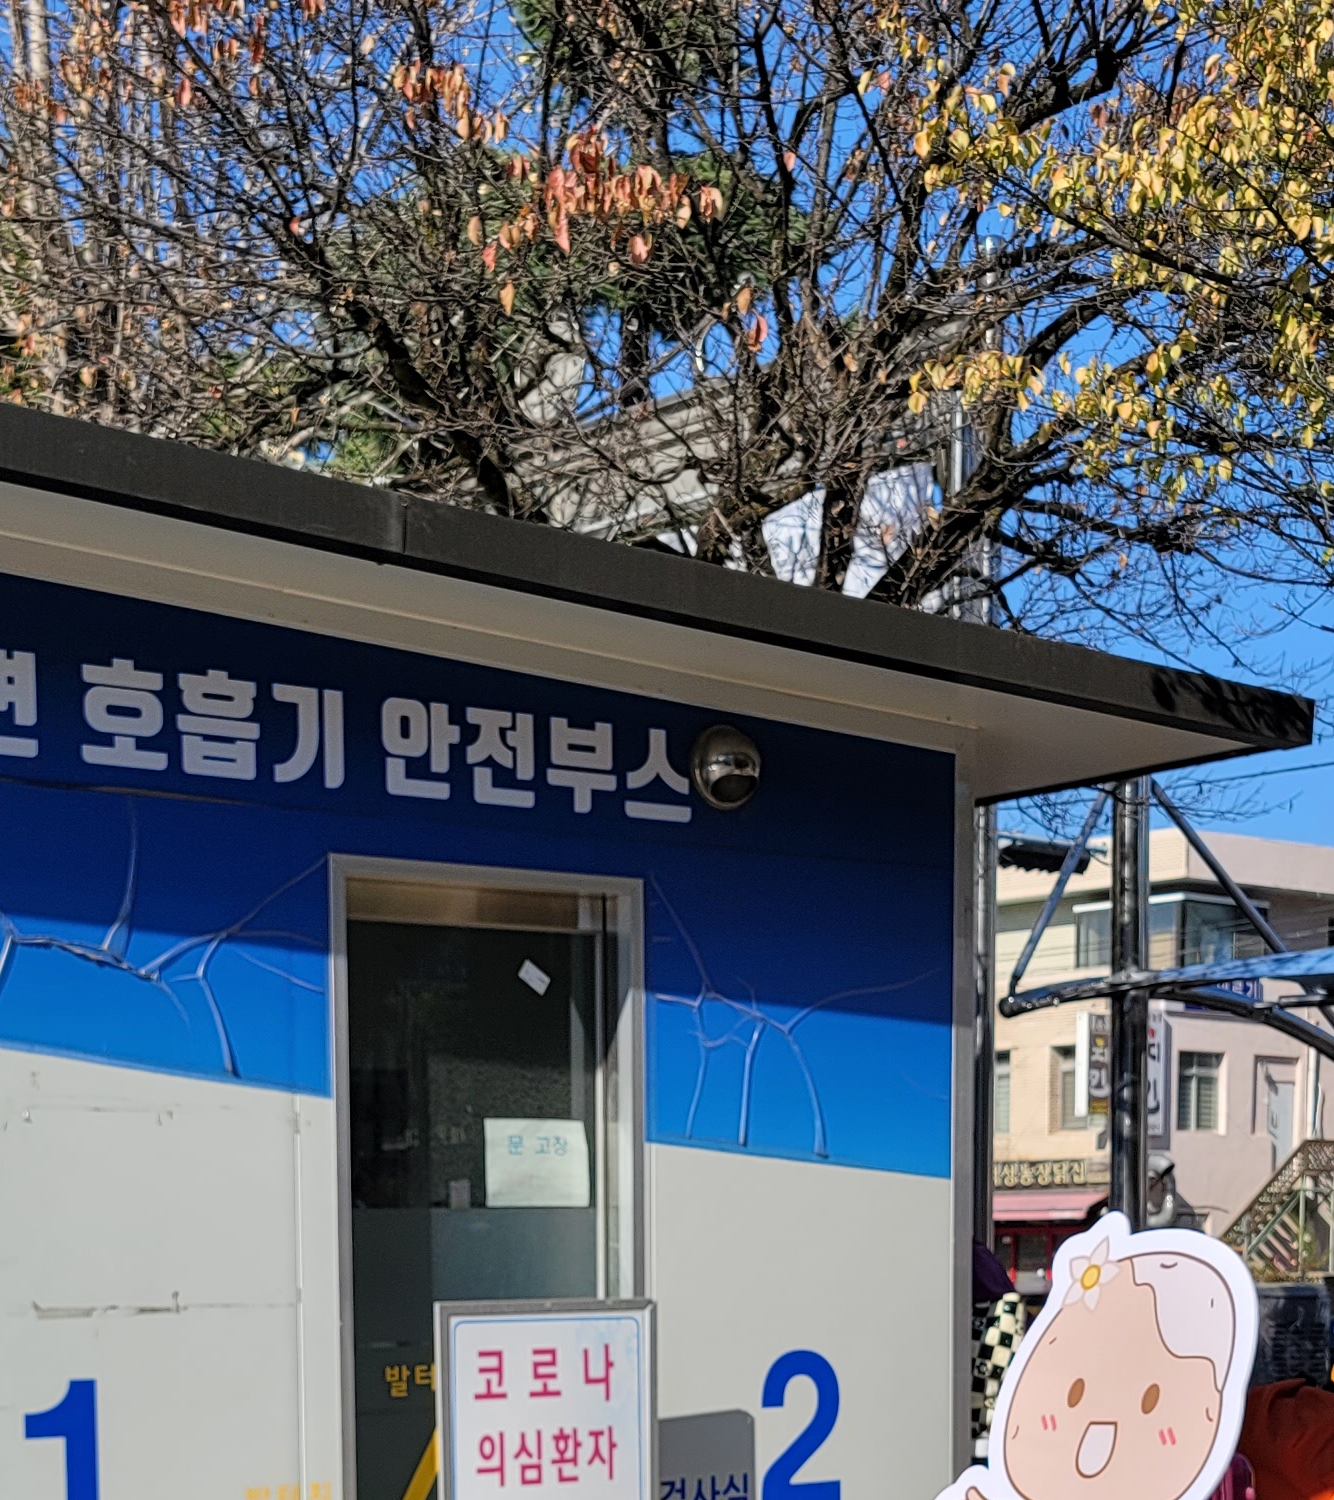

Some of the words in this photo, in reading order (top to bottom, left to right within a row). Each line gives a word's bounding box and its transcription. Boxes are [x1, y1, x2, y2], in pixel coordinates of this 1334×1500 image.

[80, 659, 345, 788] 호흡기
[381, 695, 692, 823] 안전부스
[508, 1135, 524, 1156] 문
[536, 1135, 568, 1157] 고장
[474, 1343, 615, 1402] 코로나
[476, 1426, 618, 1488] 의심환자
